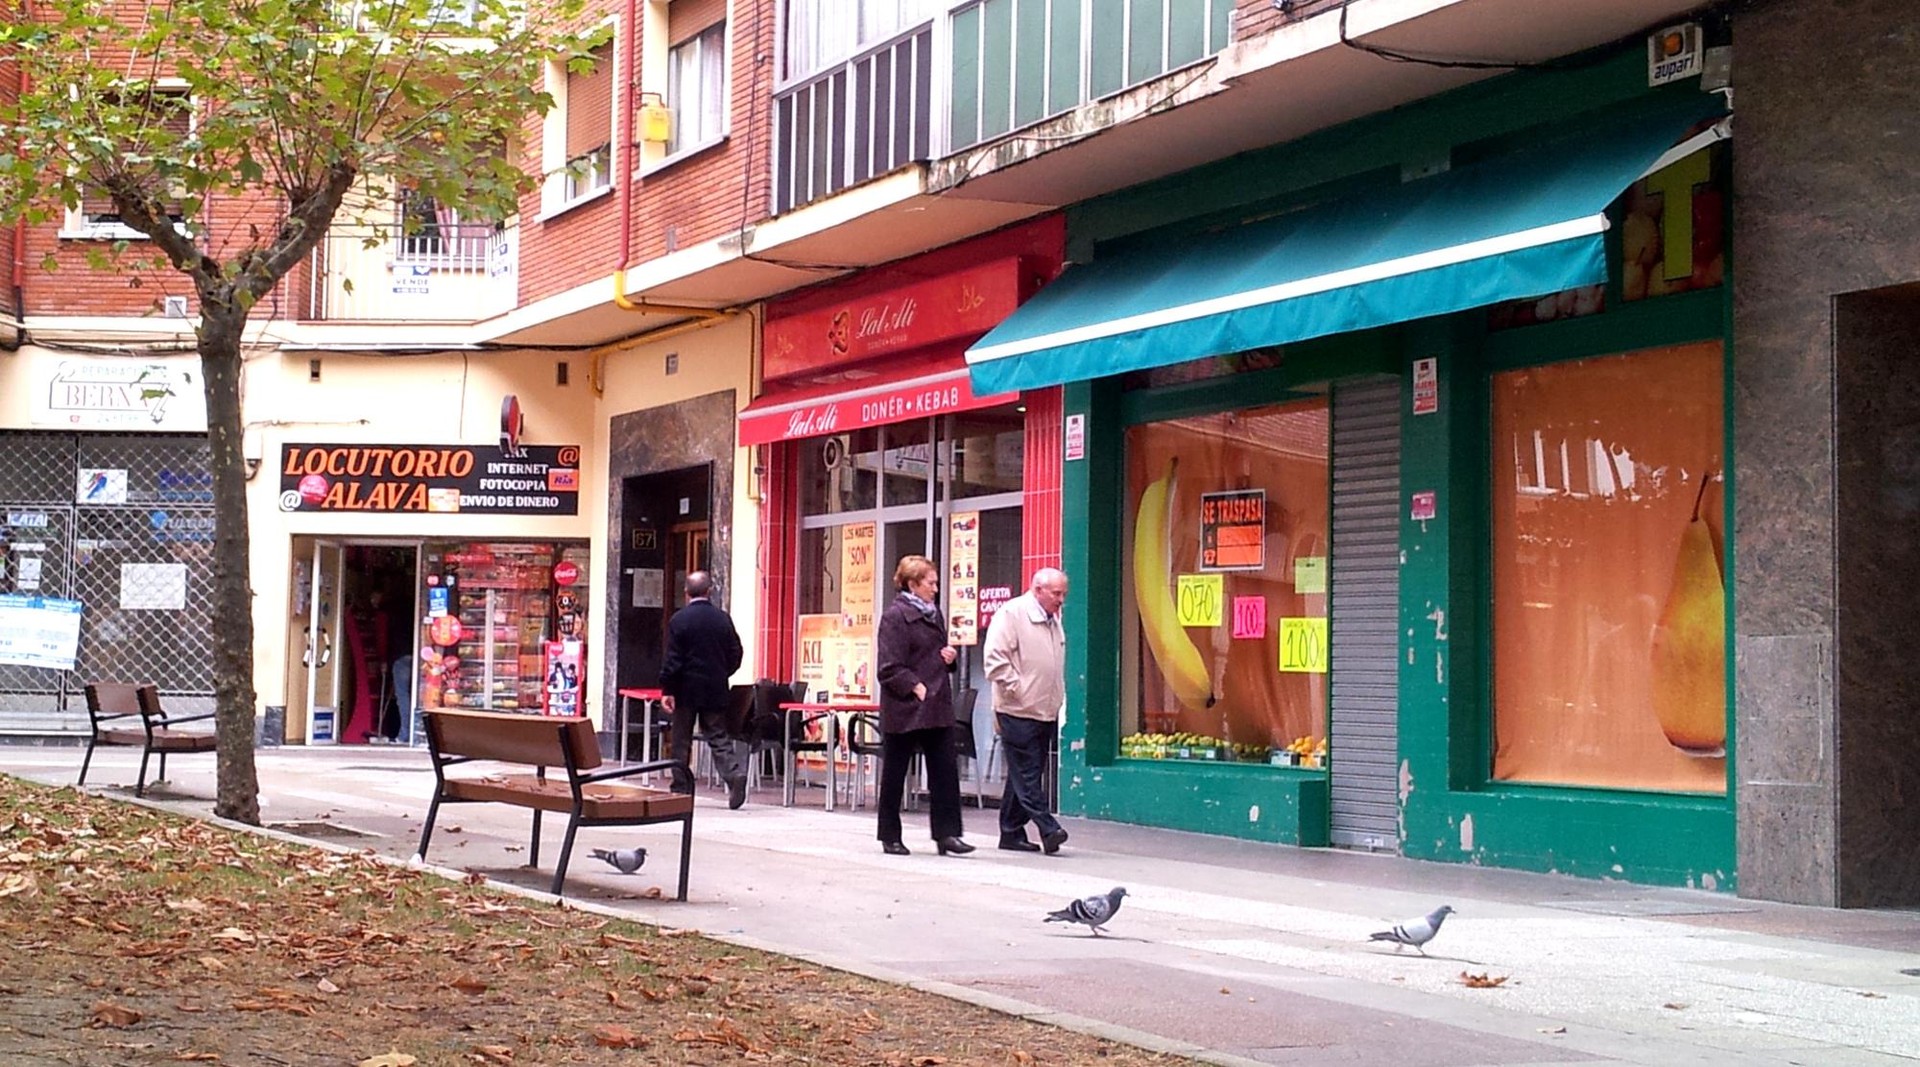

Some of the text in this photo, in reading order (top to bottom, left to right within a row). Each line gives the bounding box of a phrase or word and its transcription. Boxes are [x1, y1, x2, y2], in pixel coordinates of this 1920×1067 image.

[1654, 54, 1695, 80] aupari
[916, 387, 958, 412] KEBAB
[284, 448, 474, 478] LOCUTORIO
[487, 463, 549, 475] INTERNET
[479, 478, 547, 491] FOTOCOPIA
[321, 481, 427, 510] ALAVA
[459, 495, 496, 507] ENVIO
[497, 497, 518, 508] DE
[519, 497, 559, 508] DINERO
[1203, 497, 1263, 525] SE TRASPASA
[636, 532, 653, 547] 67
[980, 586, 1011, 600] OFERTA
